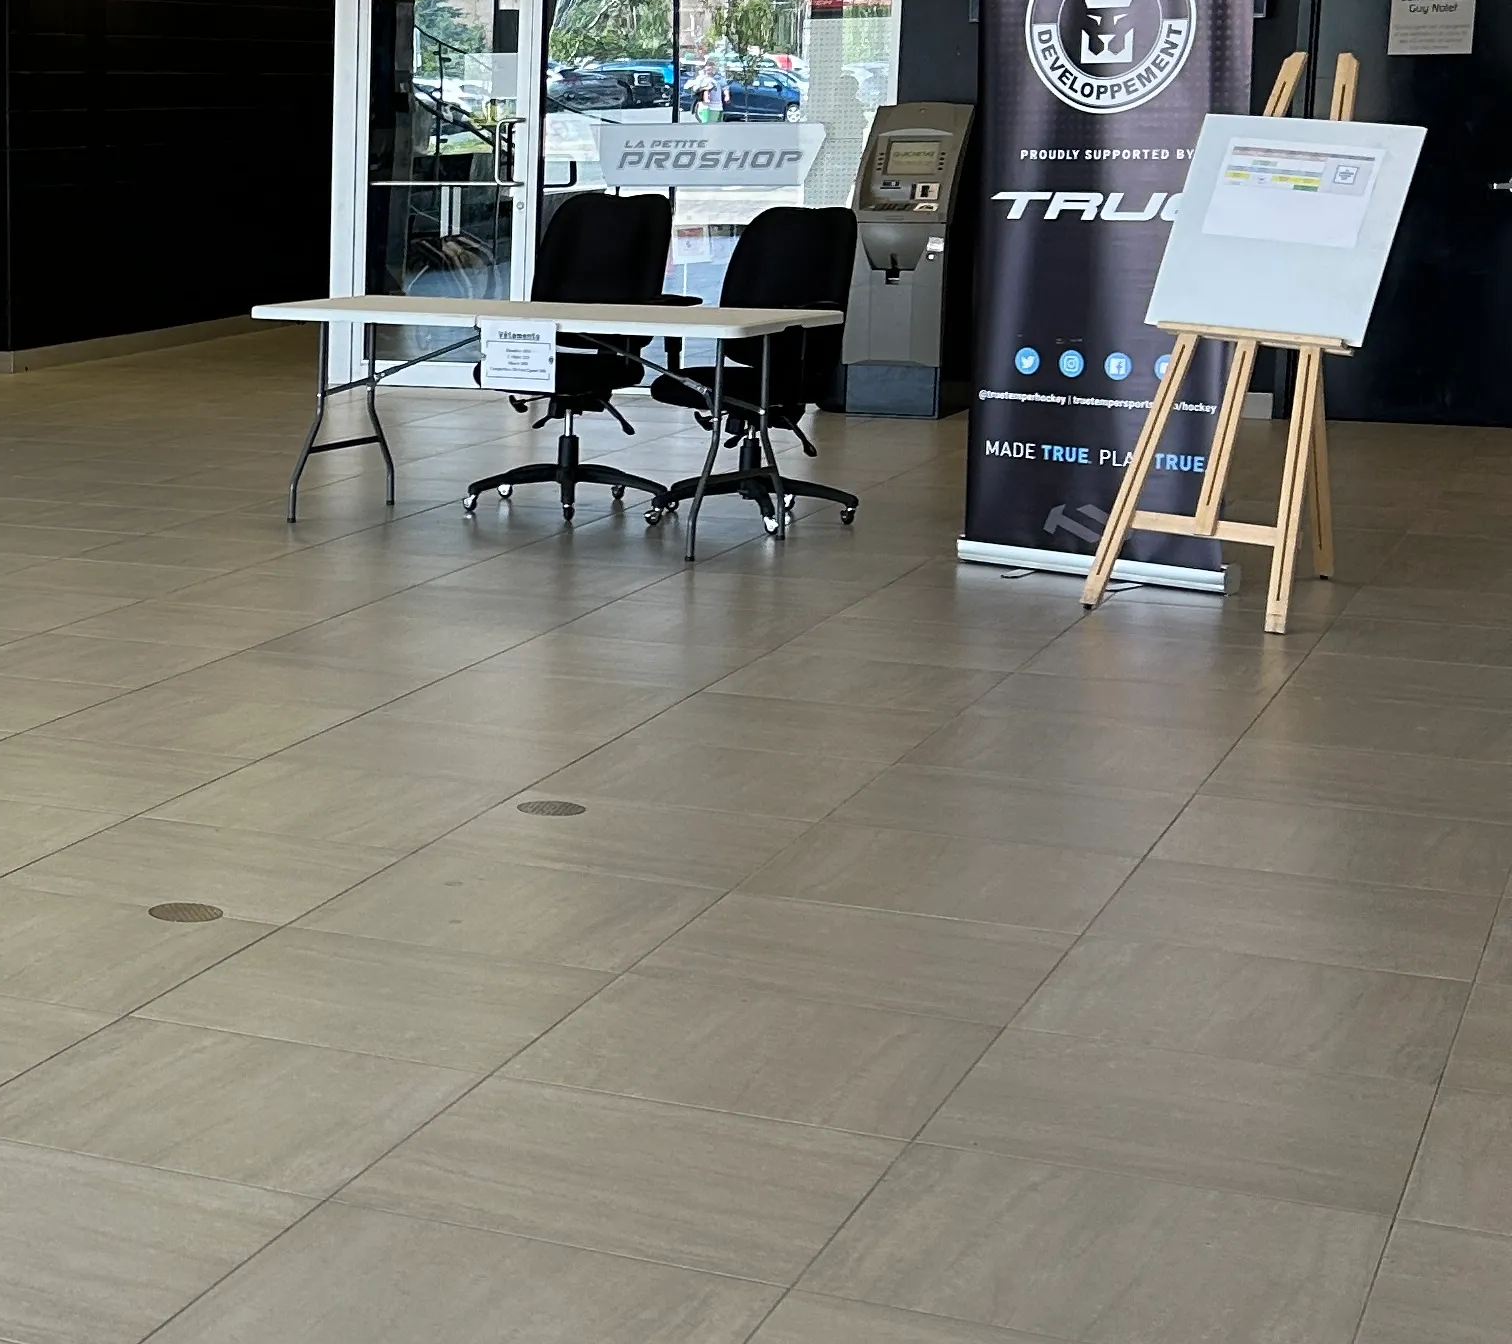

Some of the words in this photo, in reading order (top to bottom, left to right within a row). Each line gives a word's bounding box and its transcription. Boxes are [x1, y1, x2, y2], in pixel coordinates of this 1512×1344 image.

[1408, 3, 1429, 15] Guy
[1037, 23, 1183, 100] DEVELOPPEMENT
[624, 139, 645, 149] LA
[650, 139, 709, 149] PETITE
[617, 149, 804, 170] PROSHOP
[1020, 149, 1080, 160] PROUDLY
[1084, 149, 1170, 160] SUPPORTED
[1176, 149, 1196, 160] BY
[985, 440, 1036, 460] MADE
[1099, 449, 1136, 467] PLA
